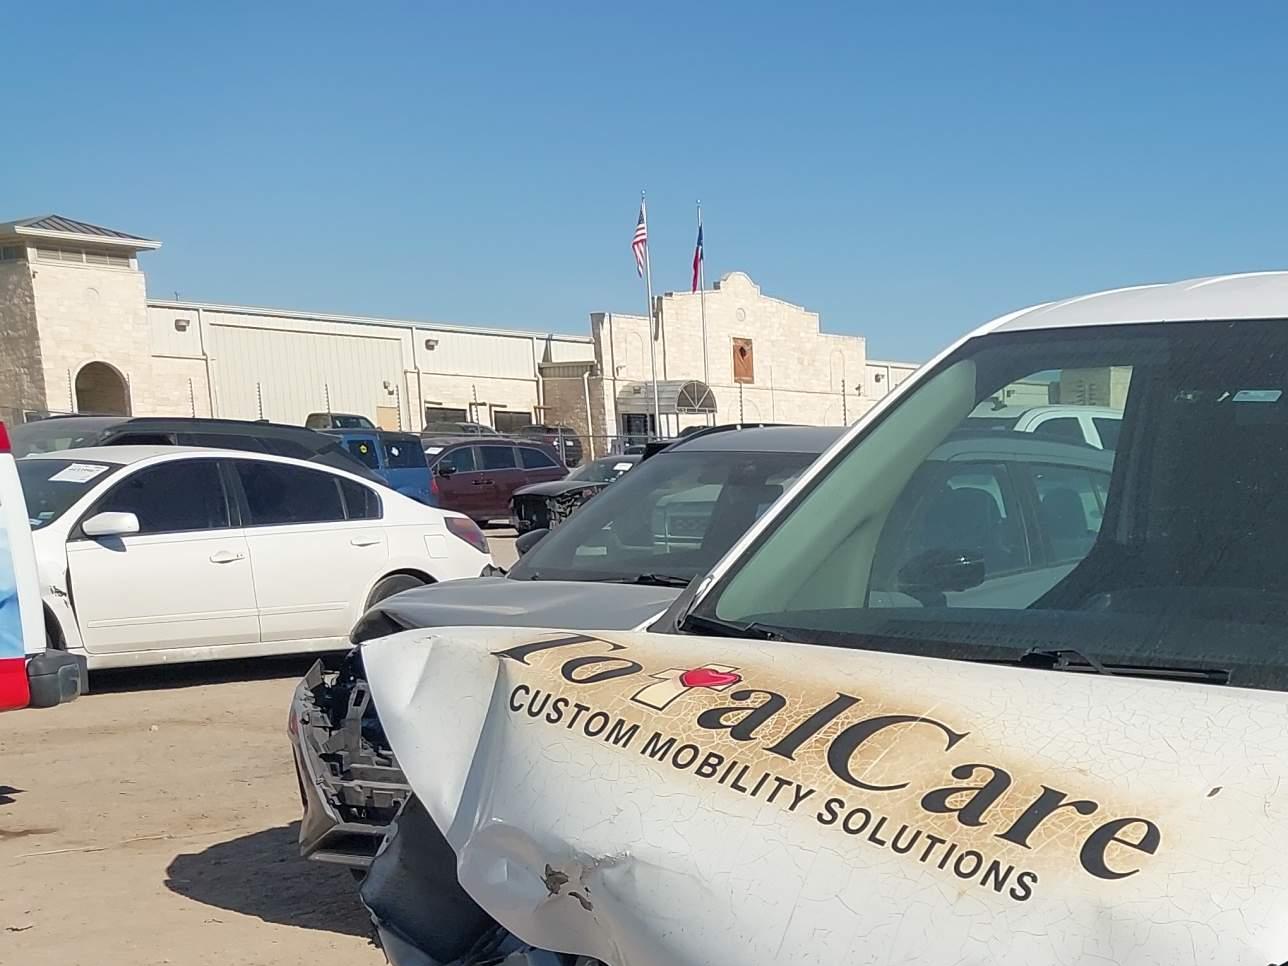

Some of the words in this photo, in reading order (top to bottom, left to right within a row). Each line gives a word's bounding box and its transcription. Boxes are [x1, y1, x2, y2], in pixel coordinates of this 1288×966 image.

[509, 684, 640, 748] CUSTOM
[640, 732, 815, 812] MOBILITY
[816, 797, 1038, 901] SOLUTIONS
